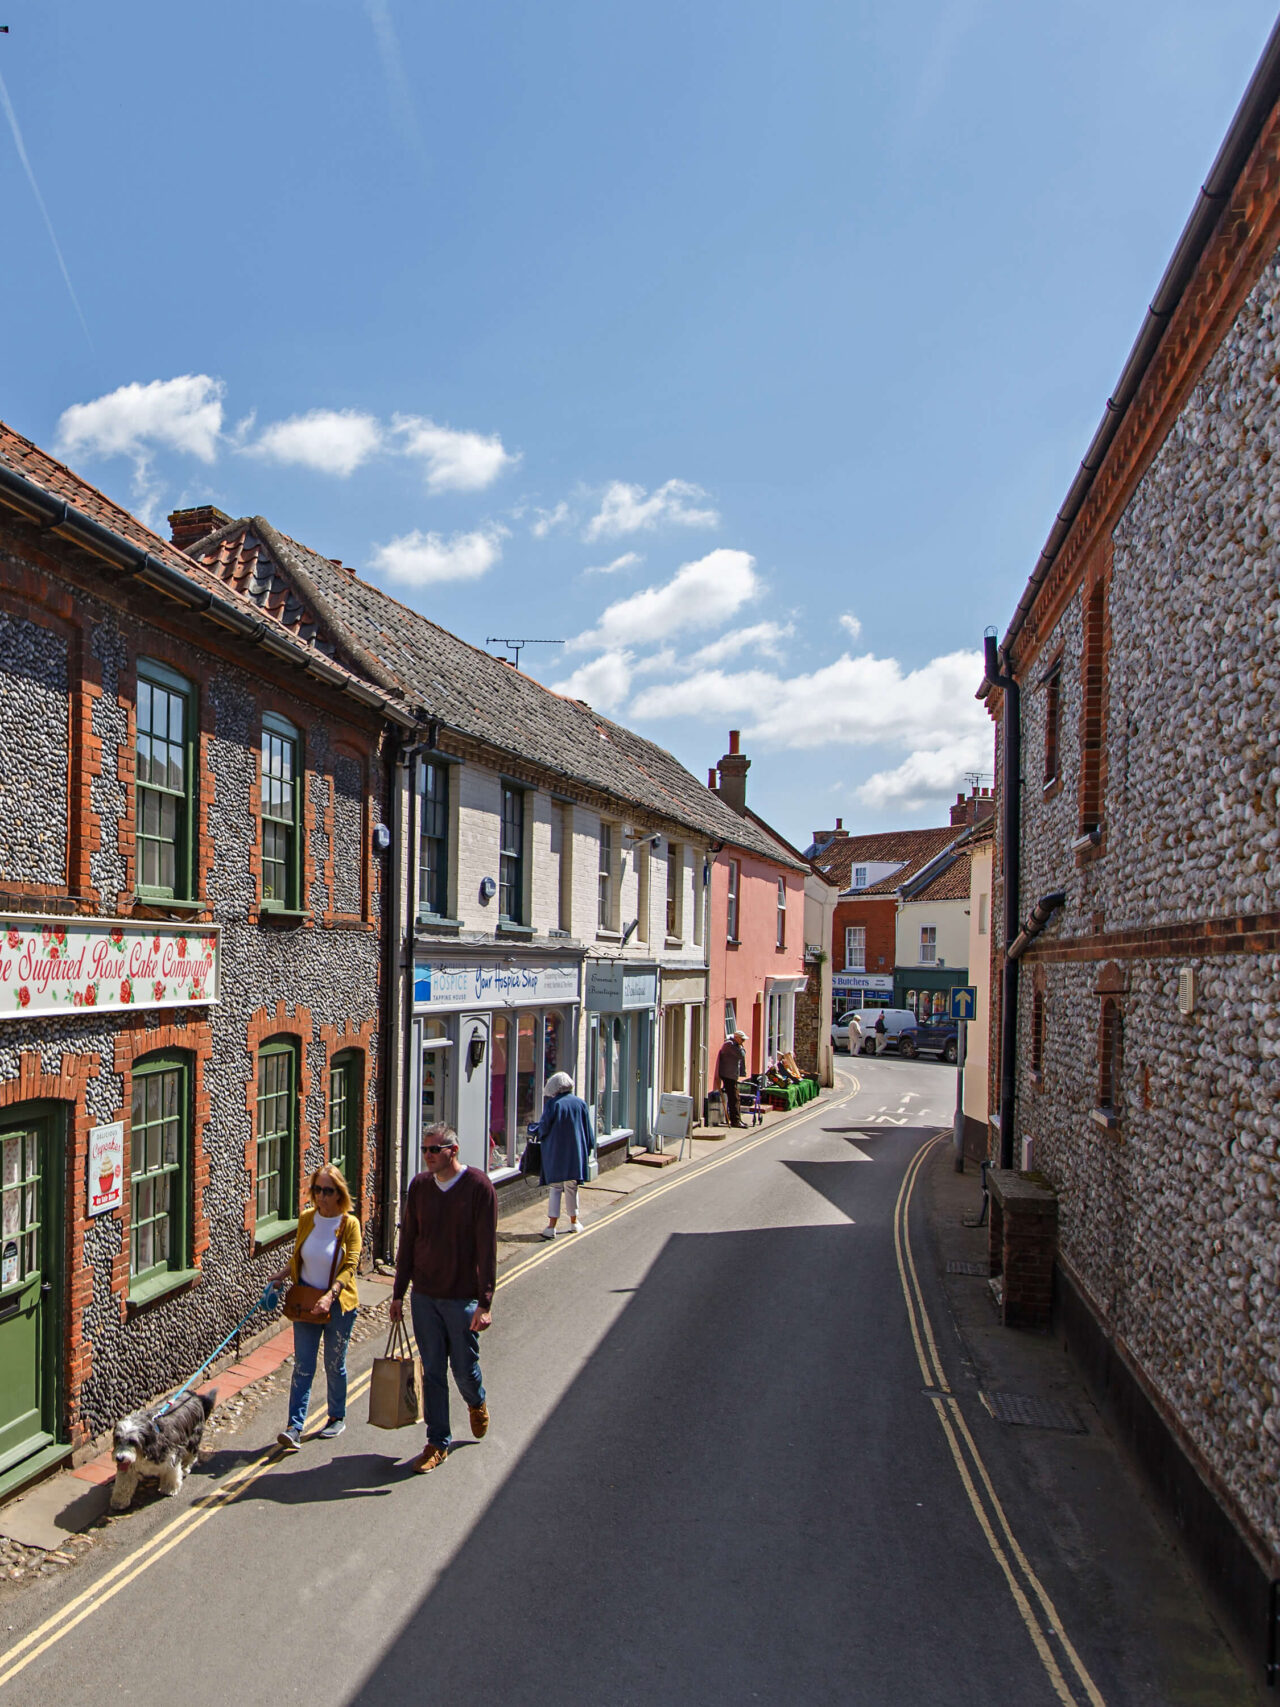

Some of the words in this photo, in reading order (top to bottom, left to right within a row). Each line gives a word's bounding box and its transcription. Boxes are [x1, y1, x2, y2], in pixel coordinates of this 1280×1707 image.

[18, 938, 86, 994] Sugared
[87, 940, 125, 980] Rose
[129, 941, 159, 979] Cake
[161, 942, 210, 989] Company
[433, 975, 468, 991] HOSPICE
[475, 964, 493, 999] Your
[494, 962, 520, 996] Hospice
[522, 968, 538, 995] Shop
[838, 977, 869, 987] Butchers
